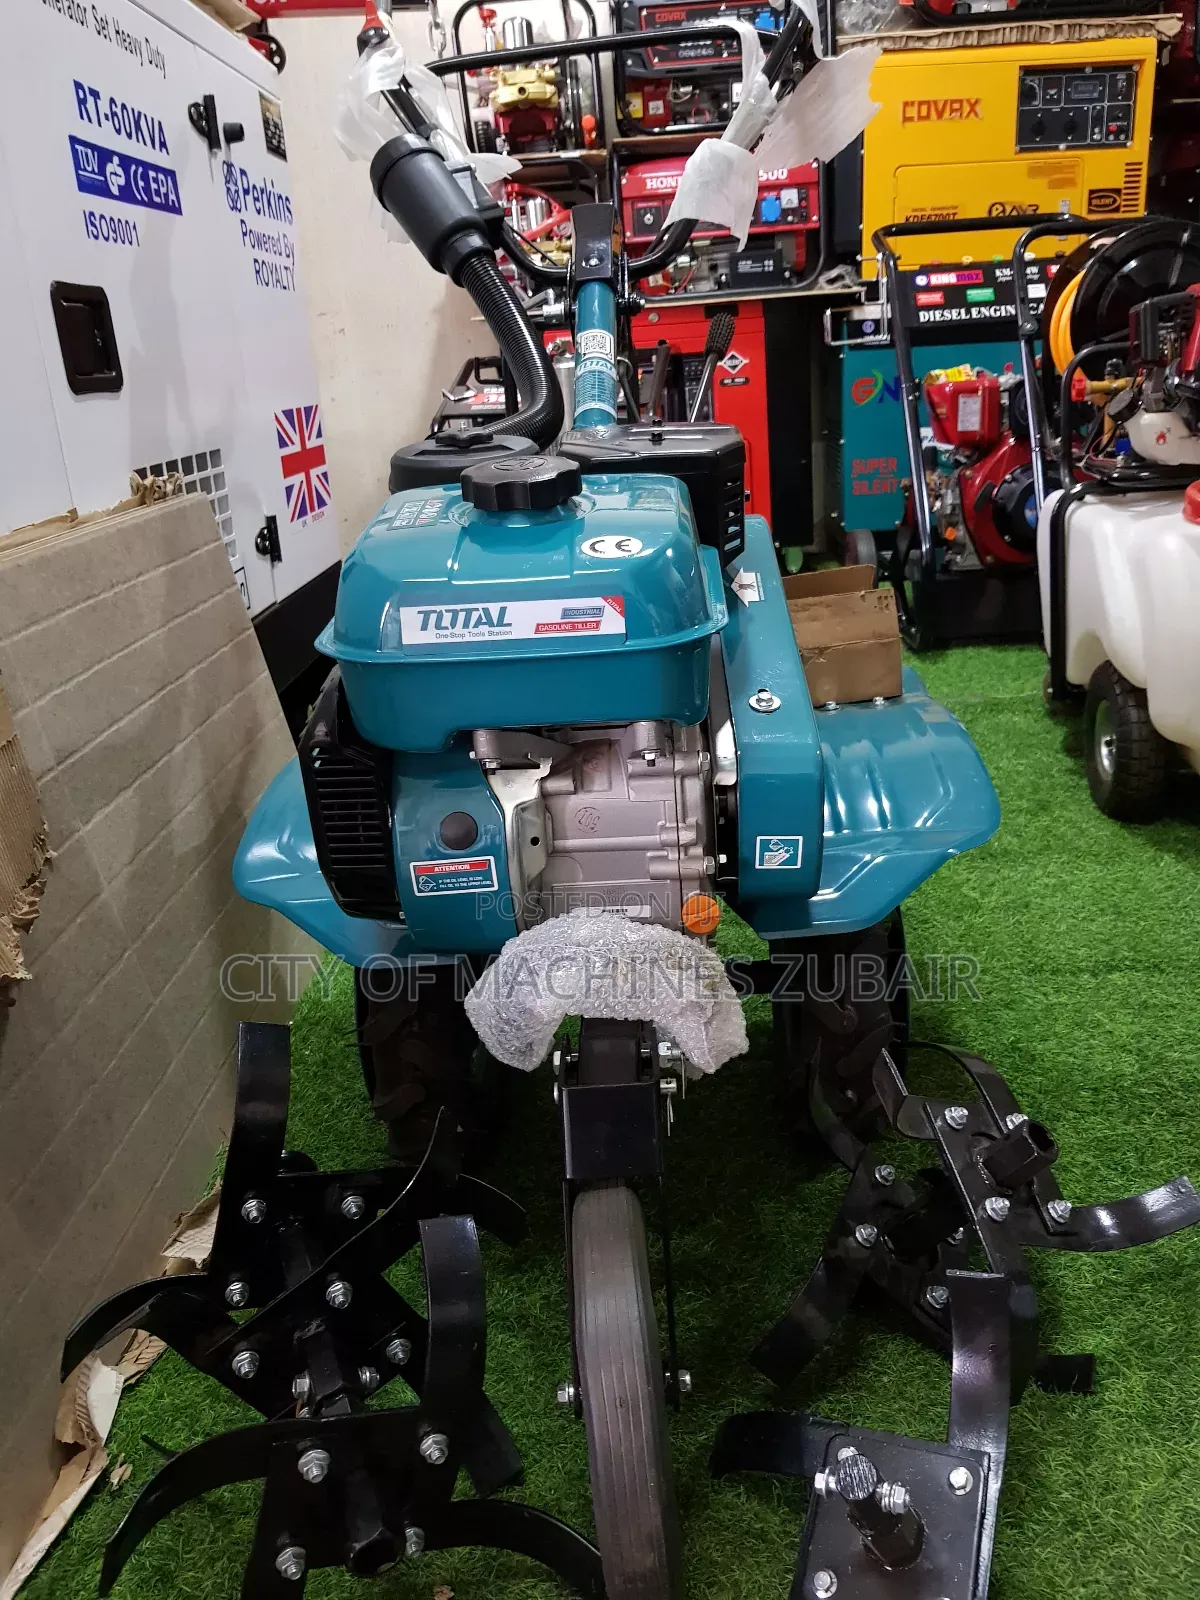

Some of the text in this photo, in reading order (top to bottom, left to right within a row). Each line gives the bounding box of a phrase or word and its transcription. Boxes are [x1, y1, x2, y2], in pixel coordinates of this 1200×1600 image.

[91, 4, 112, 42] Set
[112, 17, 144, 67] Heavy
[145, 37, 166, 80] Duty
[72, 79, 170, 156] RT-60KVA
[902, 98, 982, 124] COVAX
[148, 169, 179, 208] EPA
[645, 175, 683, 189] HON
[239, 167, 294, 226] Perkins
[82, 209, 140, 247] ISO9001
[240, 219, 295, 267] Powered By
[252, 258, 296, 292] ROYALTY
[919, 310, 970, 323] DIESEL
[970, 304, 1016, 317] ENGIN
[851, 458, 898, 478] SUPER
[852, 479, 899, 496] SILENT
[564, 608, 601, 616] INDUSTRIAL
[606, 598, 622, 612] TOTAL
[417, 606, 513, 632] TOTAL
[434, 864, 470, 872] ATTENTION
